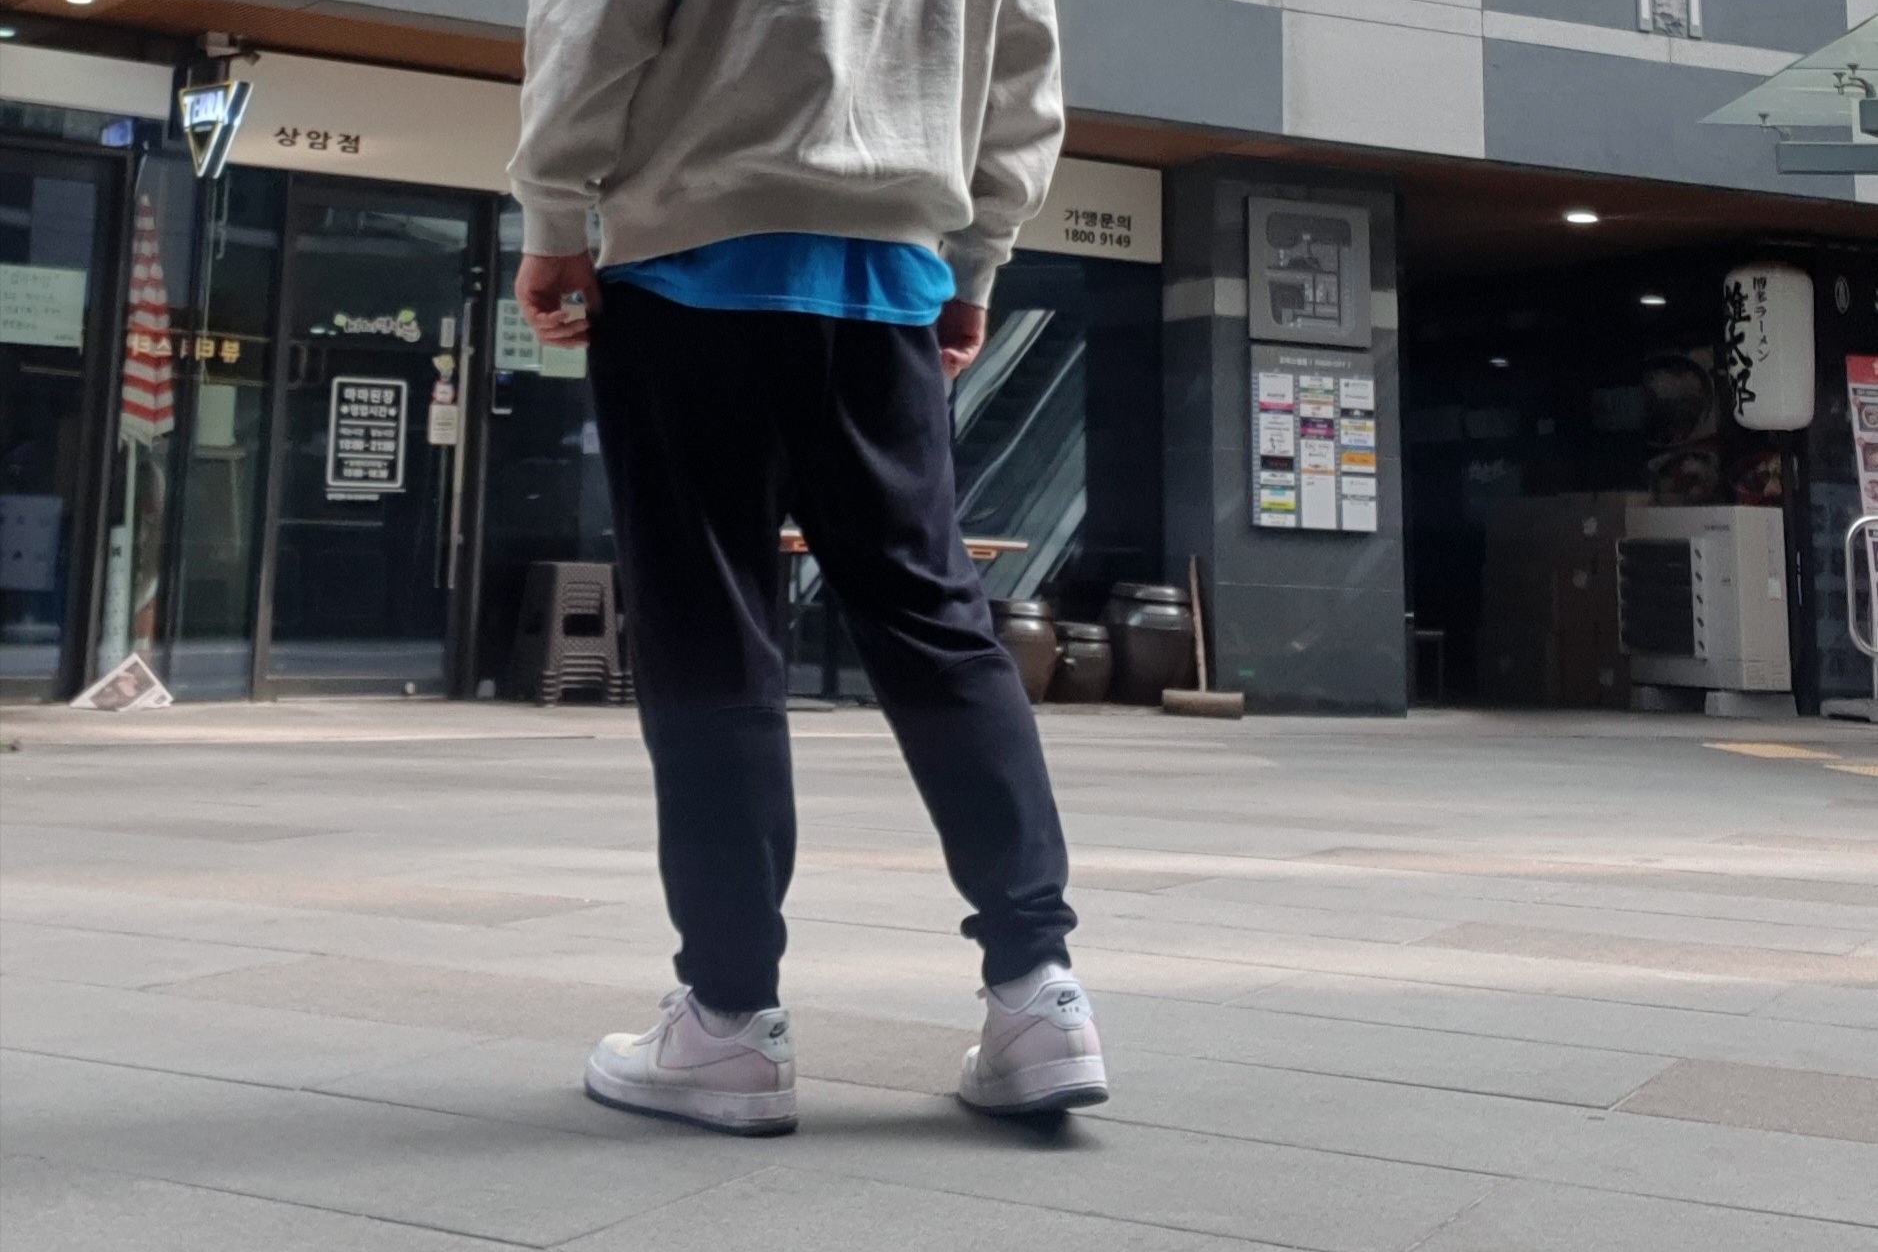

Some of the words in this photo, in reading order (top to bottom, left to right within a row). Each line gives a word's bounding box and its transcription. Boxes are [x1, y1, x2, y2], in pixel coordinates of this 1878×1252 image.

[274, 126, 361, 154] 상암점
[1064, 209, 1132, 231] 가맹문의
[1064, 228, 1096, 244] 1800
[1100, 232, 1131, 248] 9149
